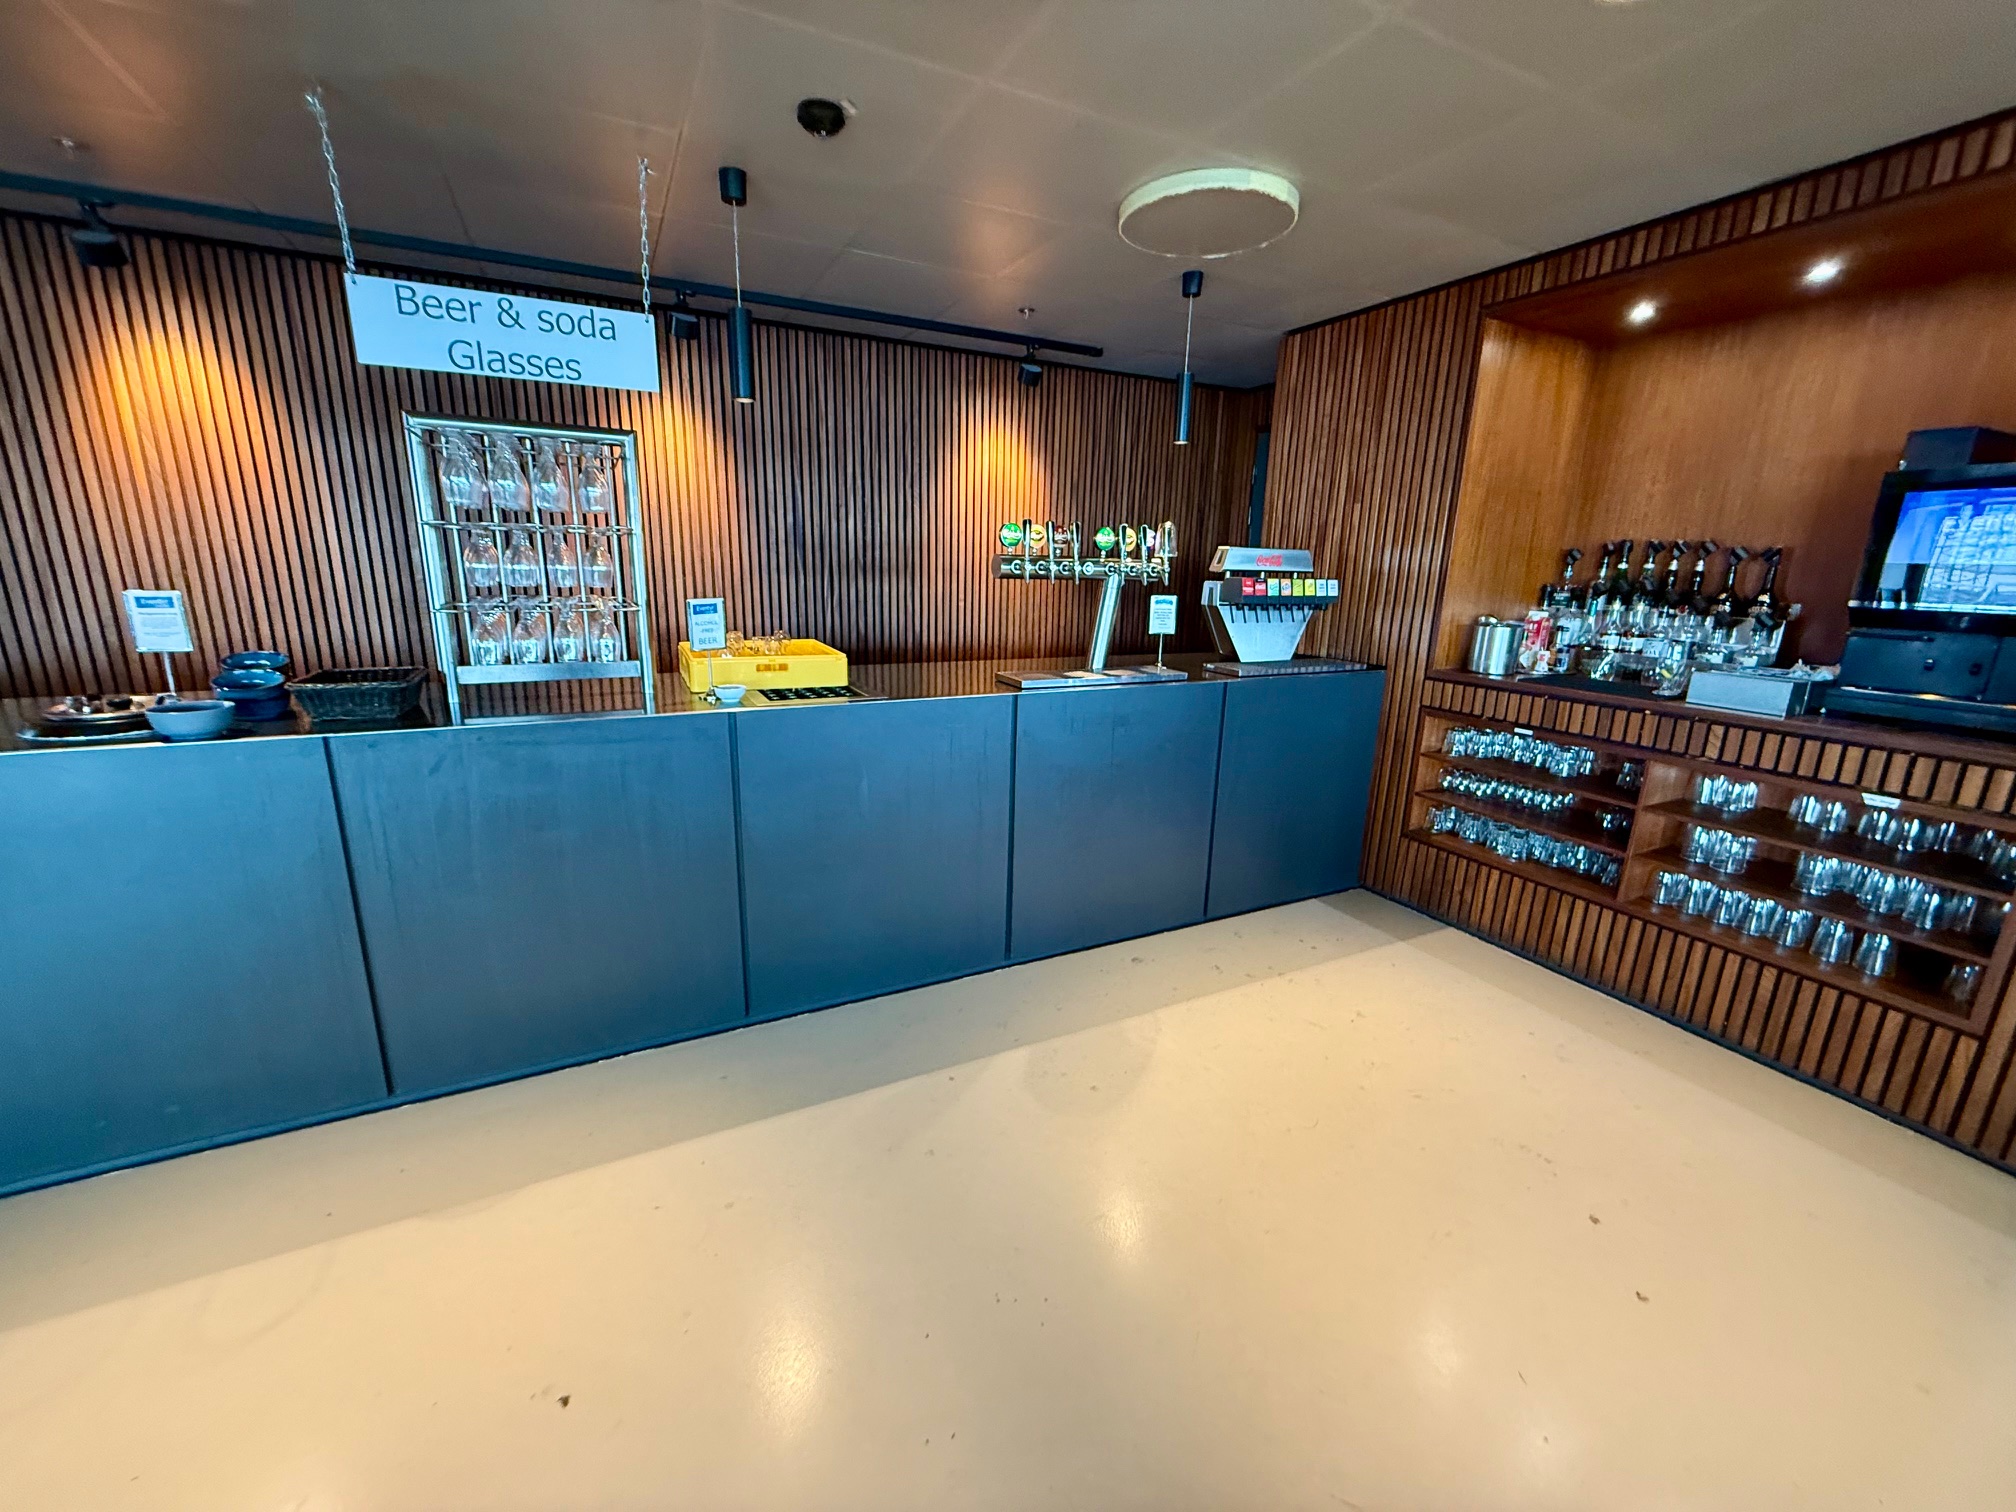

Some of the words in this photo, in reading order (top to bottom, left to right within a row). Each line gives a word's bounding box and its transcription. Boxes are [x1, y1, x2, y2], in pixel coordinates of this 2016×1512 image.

[395, 284, 481, 323] Beer
[498, 298, 526, 330] &
[538, 310, 616, 340] soda
[449, 340, 581, 380] Glasses
[699, 637, 717, 645] BEER
